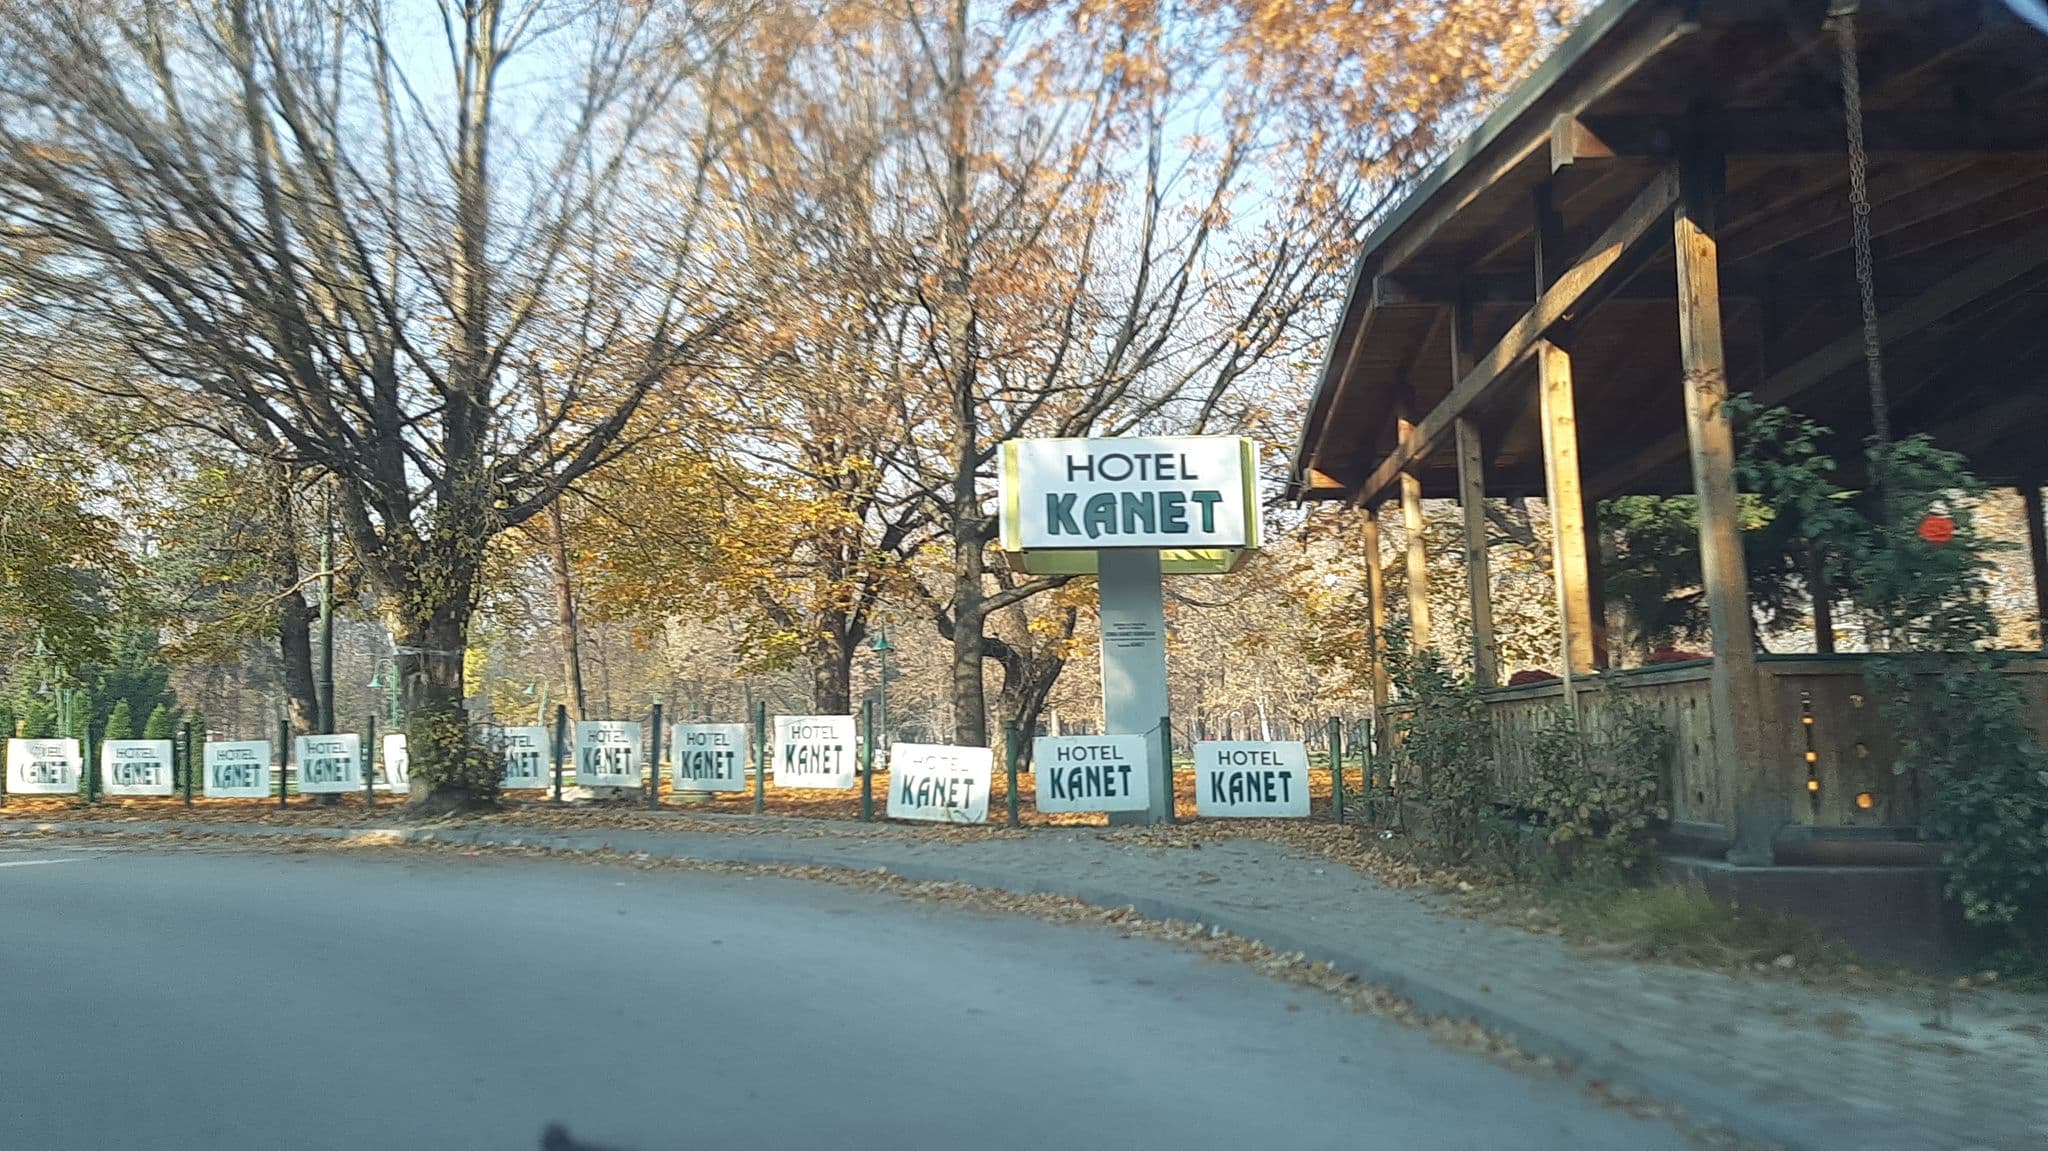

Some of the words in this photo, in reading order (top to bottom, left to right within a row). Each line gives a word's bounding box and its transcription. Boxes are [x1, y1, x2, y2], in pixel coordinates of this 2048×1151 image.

[1066, 453, 1199, 482] HOTEL
[1046, 490, 1223, 540] KANET
[503, 735, 536, 747] TEL
[686, 732, 730, 746] HOTEL
[791, 725, 839, 739] HOTEL
[216, 749, 257, 760] HOTEL
[307, 742, 349, 754] HOTEL
[784, 744, 843, 775] KANET
[1057, 745, 1124, 761] HOTEL
[1218, 750, 1284, 766] HOTEL
[303, 758, 351, 783] KANET
[505, 751, 540, 777] NET
[582, 747, 632, 775] KANET
[681, 750, 734, 780] KANET
[111, 762, 162, 786] KANET
[212, 764, 261, 788] KANET
[1050, 764, 1132, 801] KANET
[901, 774, 975, 809] KANET
[1211, 771, 1292, 806] KANET
